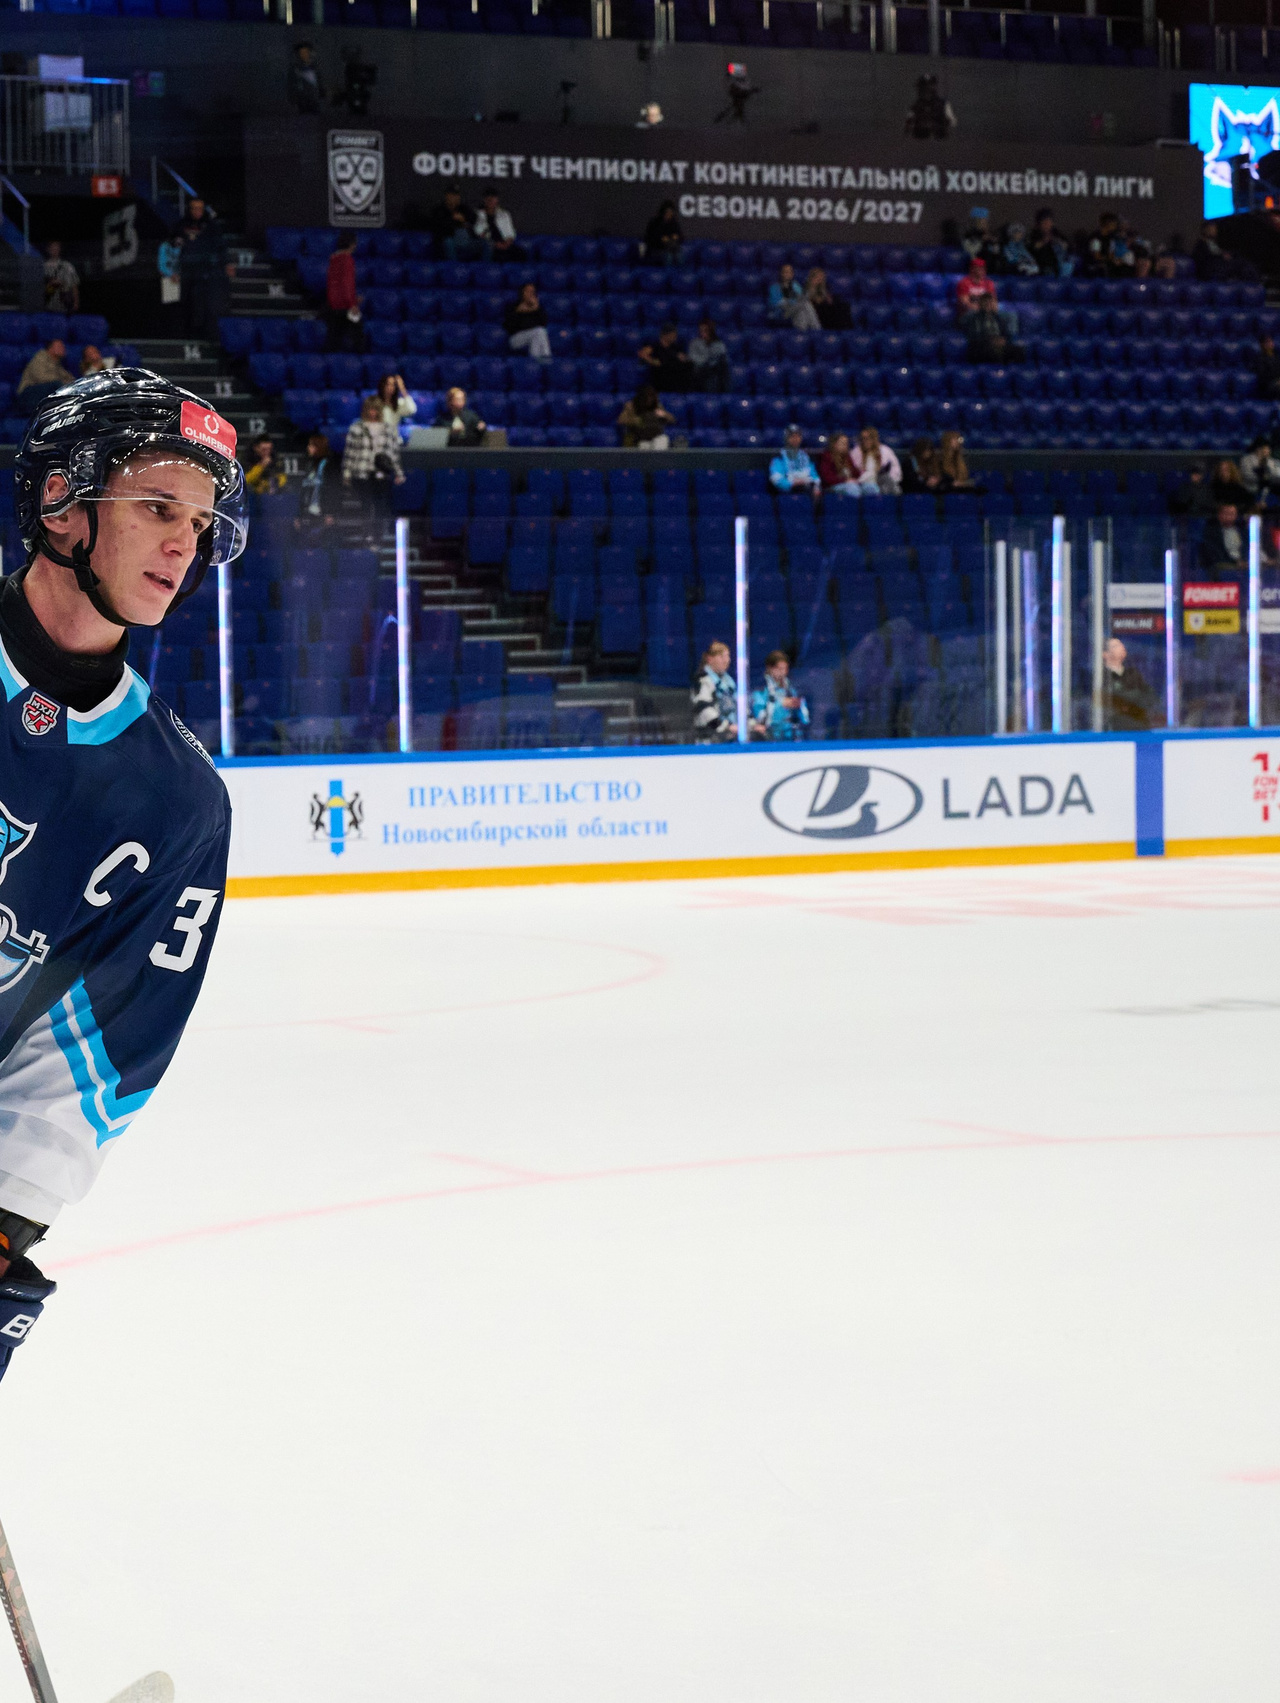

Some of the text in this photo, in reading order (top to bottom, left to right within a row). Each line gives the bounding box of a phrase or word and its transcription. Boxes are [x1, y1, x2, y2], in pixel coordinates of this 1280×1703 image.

[412, 152, 1155, 198] ФОНБЕТ ЧЕМПИОНАТ КОНТИНЕНТАЛЬНОЙ ХОККЕЙНОЙ ЛИГИ
[678, 194, 924, 224] СЕЗОНА 2026/2027
[31, 699, 55, 718] МХЛ
[408, 780, 643, 808] ПРАВИТЕЛЬСТВО
[942, 773, 1094, 820] LADA
[381, 816, 669, 847] Новосибирской области
